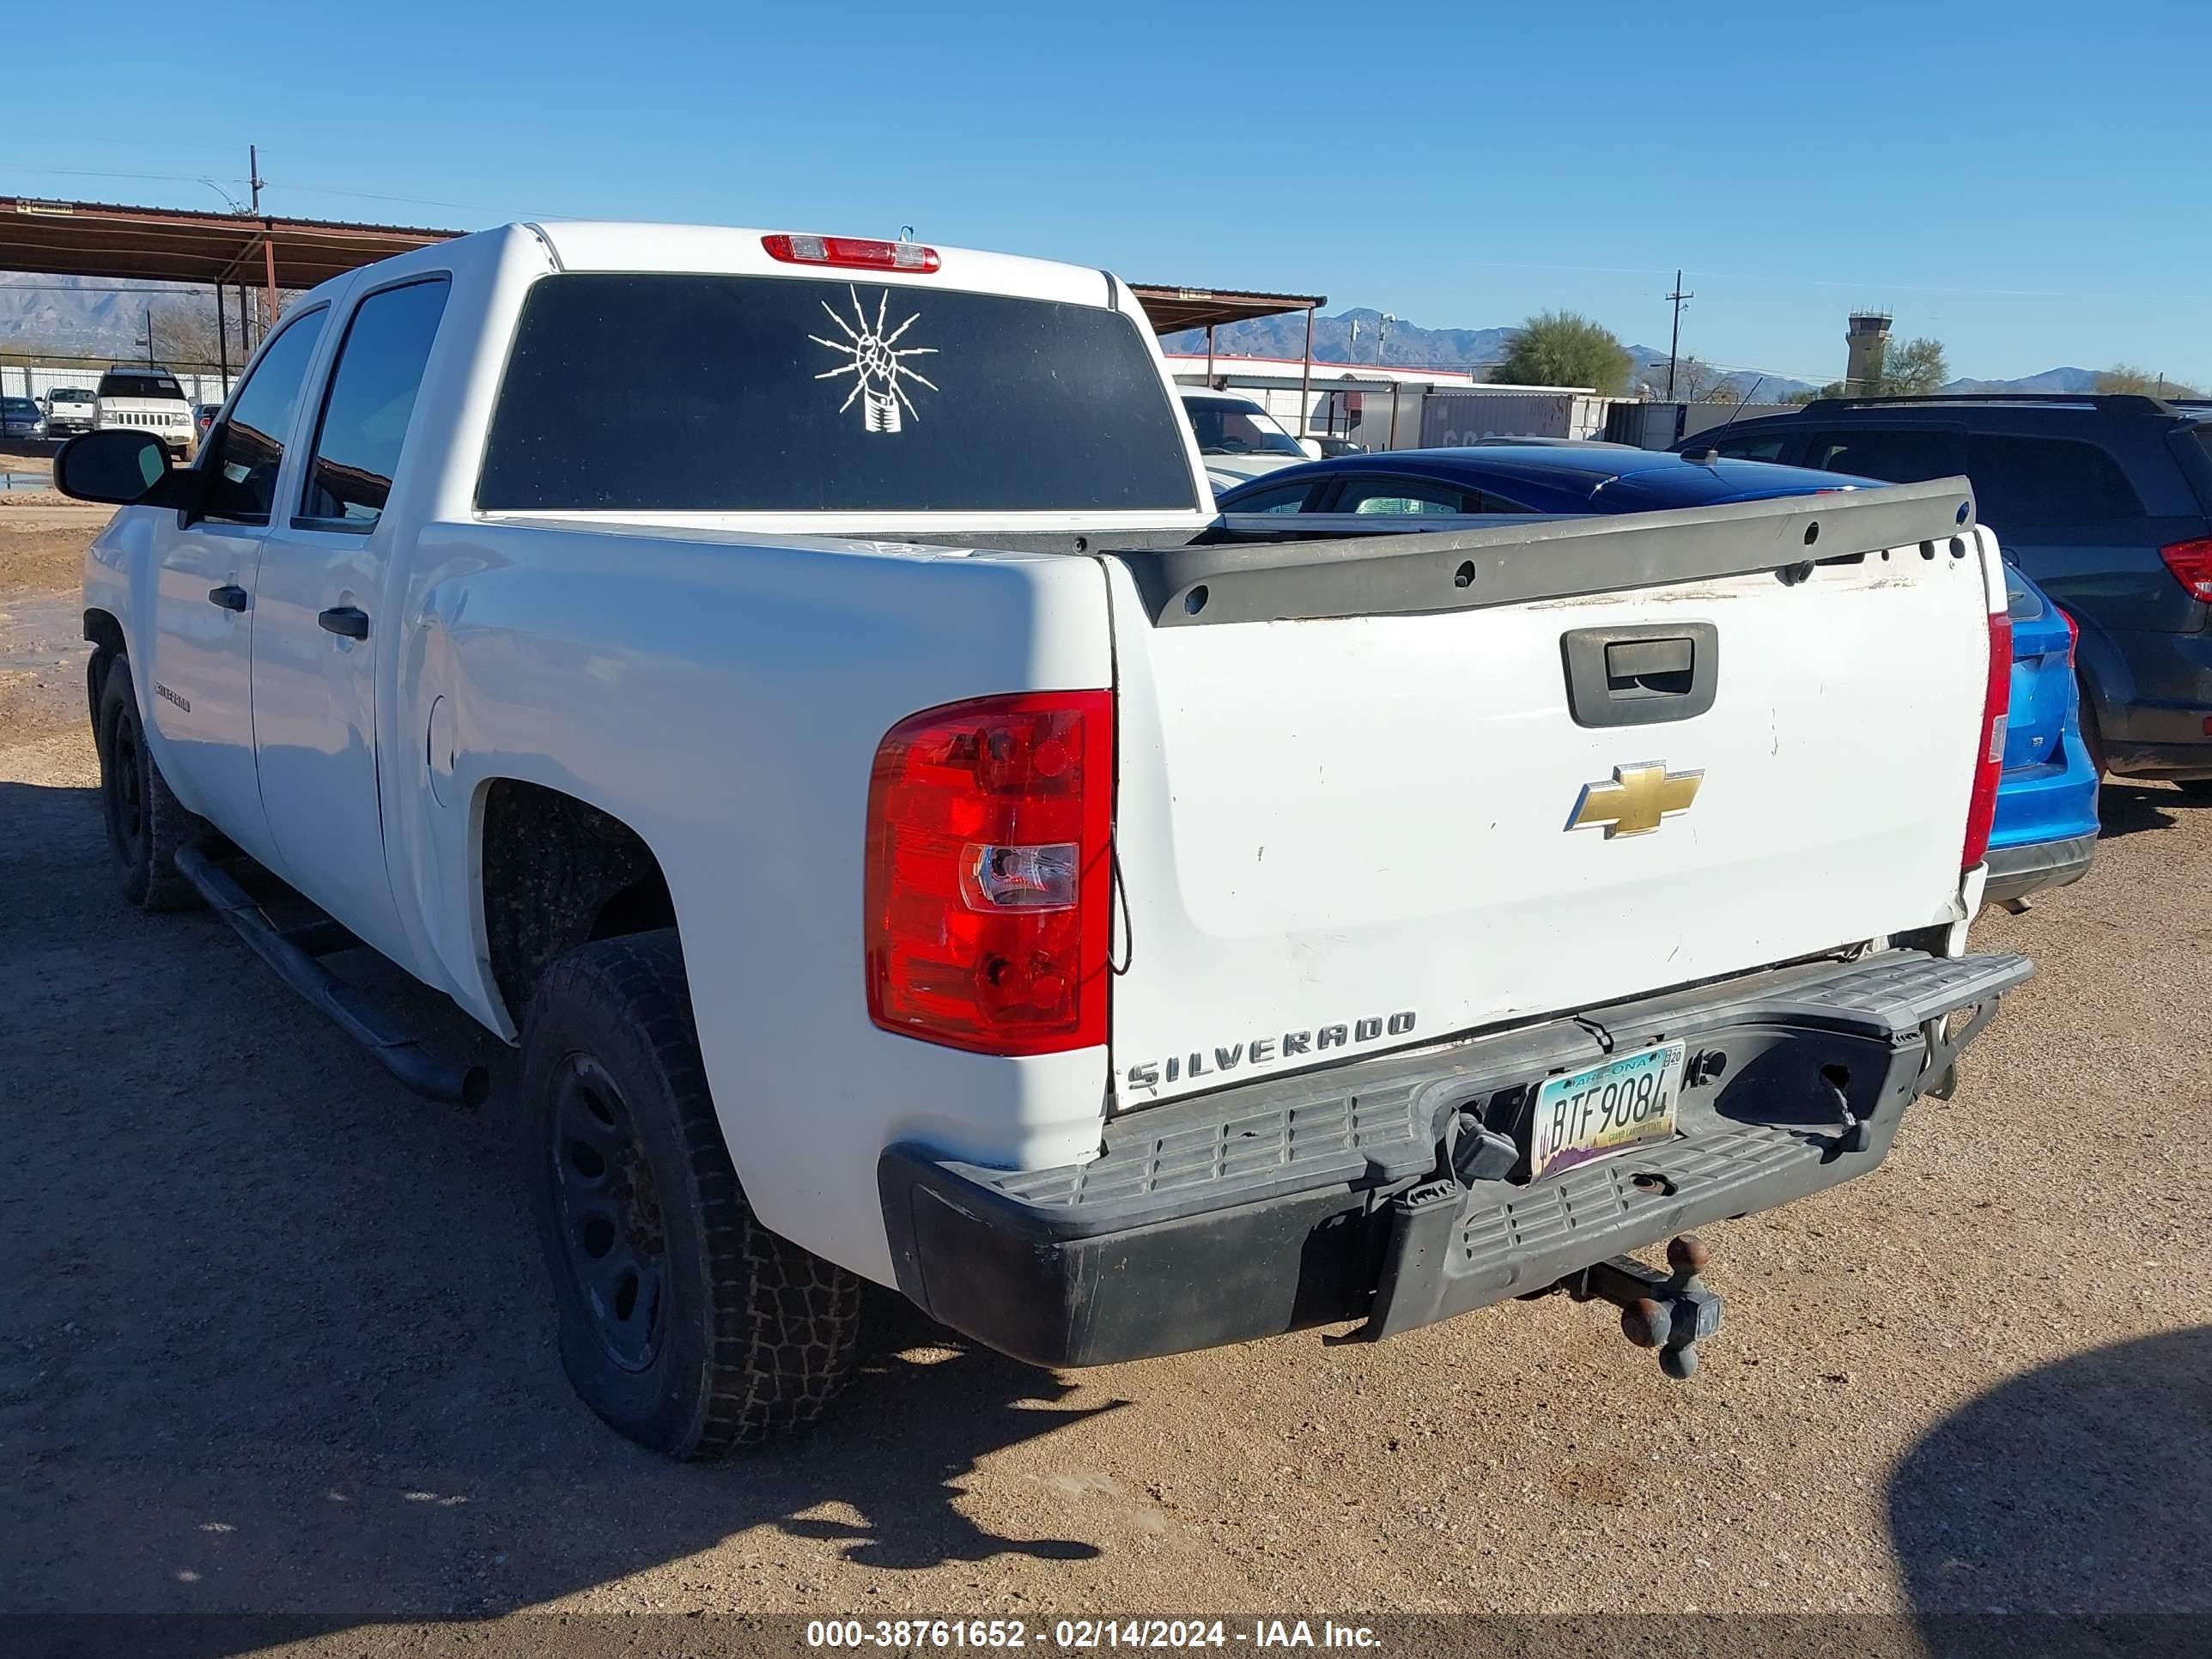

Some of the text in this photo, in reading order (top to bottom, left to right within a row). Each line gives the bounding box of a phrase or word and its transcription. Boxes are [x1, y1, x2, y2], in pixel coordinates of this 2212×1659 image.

[20, 201, 28, 211] 4
[1127, 1010, 1417, 1090] SILVERADO
[1550, 1069, 1668, 1154] BTF9084
